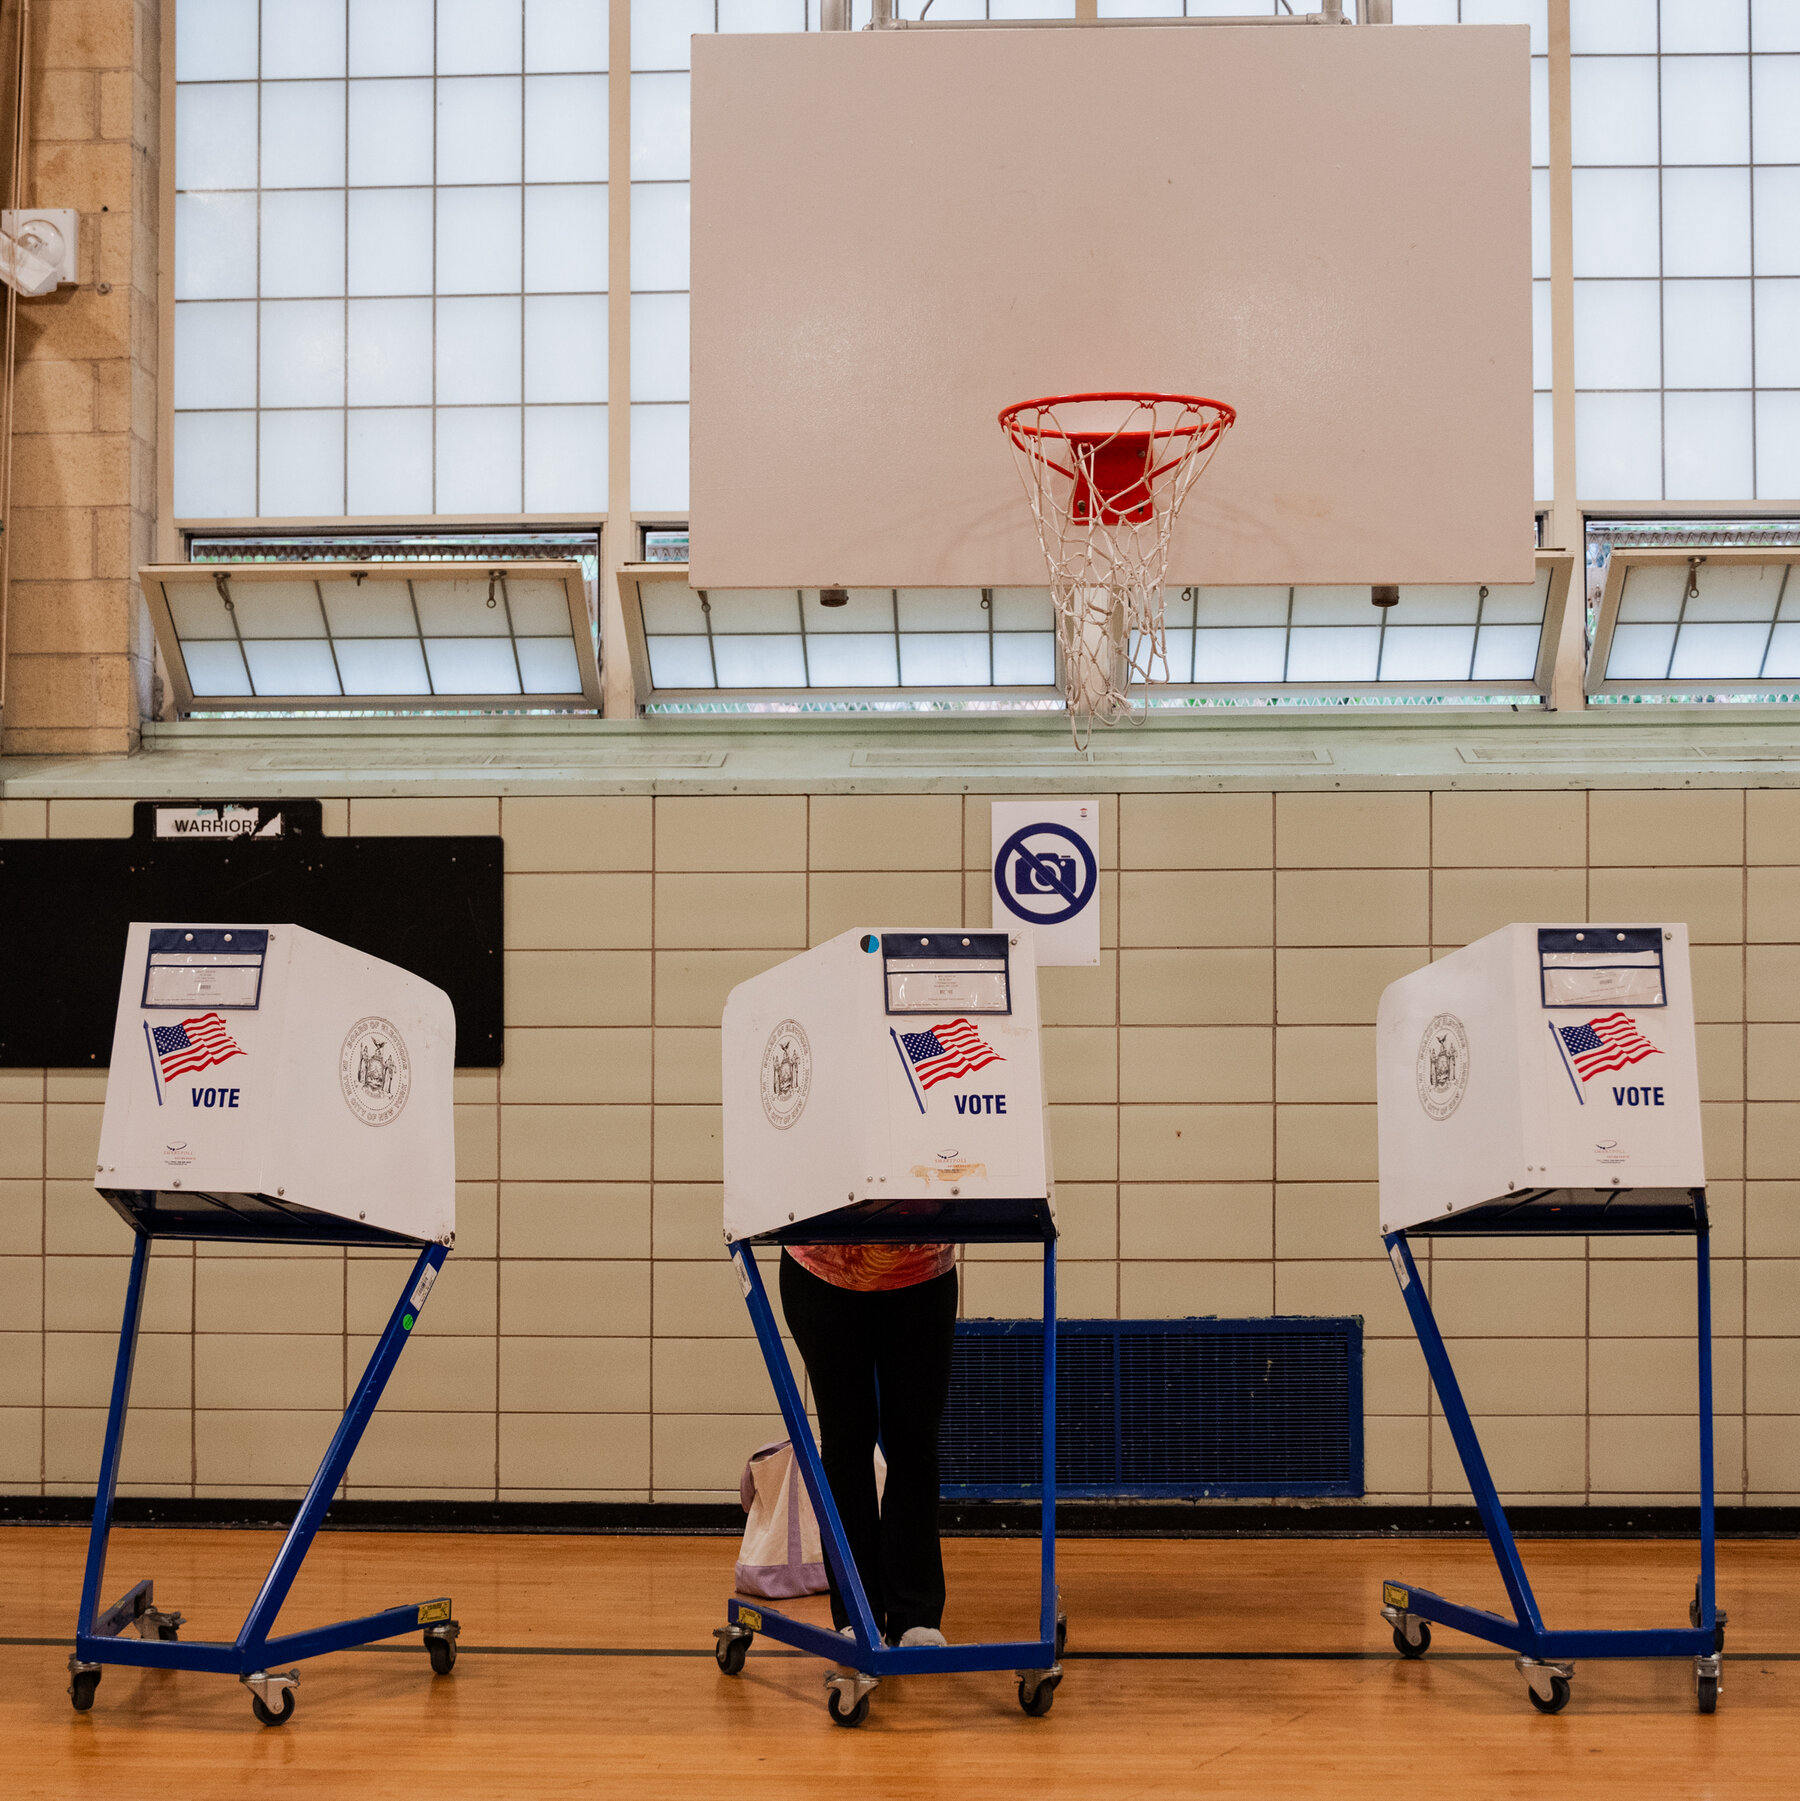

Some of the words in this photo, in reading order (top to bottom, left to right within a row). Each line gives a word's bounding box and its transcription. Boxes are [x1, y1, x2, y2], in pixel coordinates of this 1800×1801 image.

[191, 1087, 240, 1108] VOTE
[954, 1094, 1007, 1115] VOTE
[1612, 1086, 1665, 1106] VOTE
